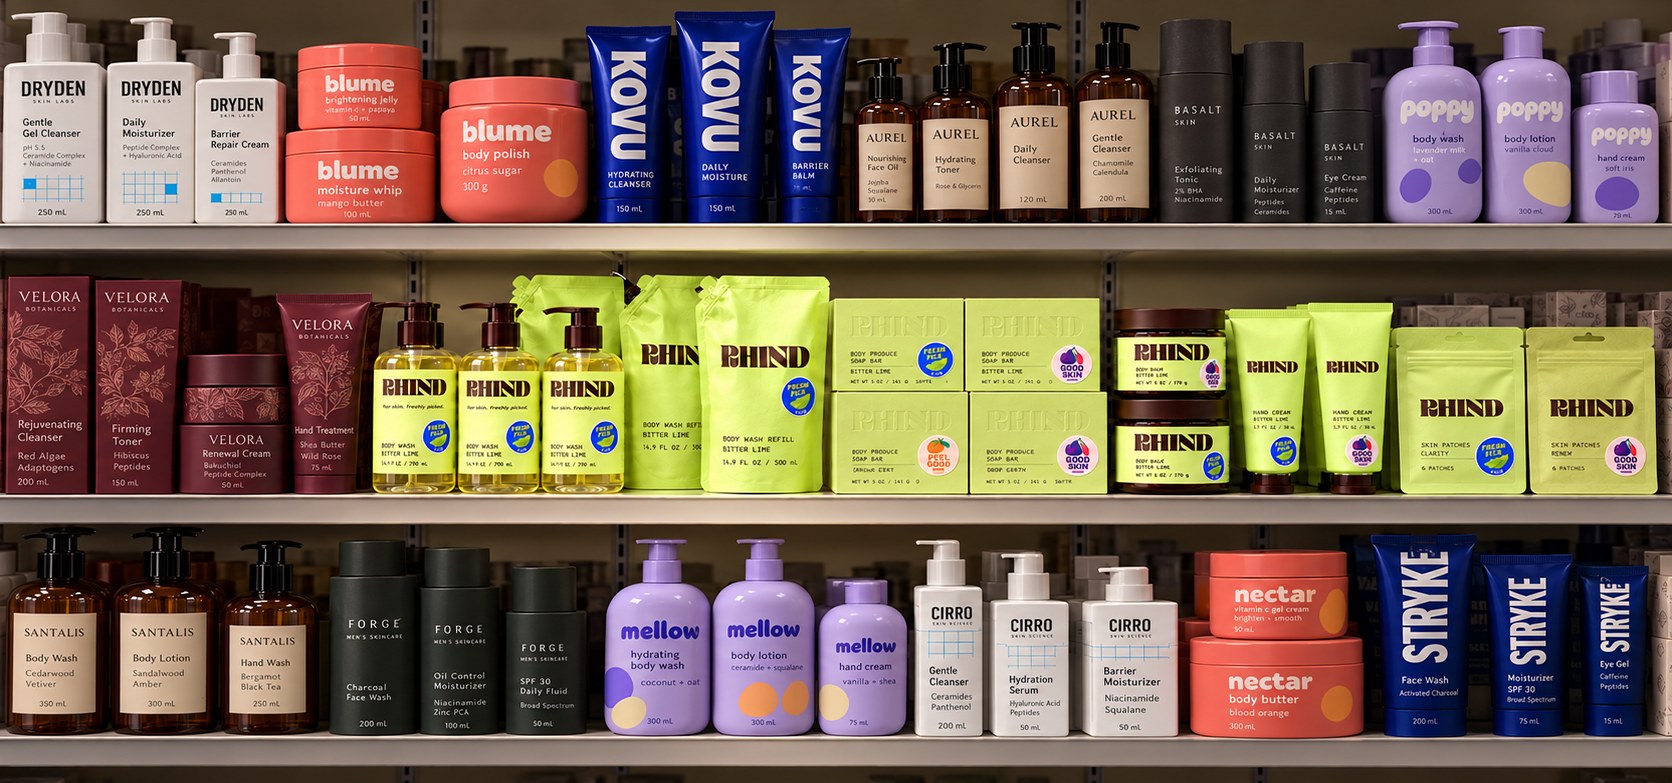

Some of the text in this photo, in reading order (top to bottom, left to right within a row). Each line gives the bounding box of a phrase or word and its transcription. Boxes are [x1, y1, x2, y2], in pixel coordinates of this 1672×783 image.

[22, 81, 85, 96] DRYDEN
[122, 81, 181, 96] DRYDEN
[325, 74, 394, 93] blume
[326, 96, 399, 105] brightening jelly
[700, 42, 740, 151] KOVU
[211, 98, 263, 111] DRYDEN
[609, 51, 647, 159] KOVU
[792, 56, 822, 151] KOVU
[1175, 106, 1221, 114] BASALT
[1400, 98, 1475, 126] poppy
[1496, 101, 1562, 124] poppy
[23, 118, 52, 126] Gentle
[123, 118, 146, 128] Daily
[1011, 117, 1058, 127] AUREL
[23, 129, 80, 137] Gel Cleanser
[463, 119, 551, 143] blume
[933, 129, 979, 139] AUREL
[1254, 132, 1295, 140] BASALT
[867, 133, 908, 142] AUREL
[1504, 135, 1527, 144] body
[1591, 128, 1652, 146] poppy
[212, 141, 238, 150] Repair
[1014, 145, 1037, 154] Daily
[463, 149, 531, 162] body polish
[934, 155, 976, 166] Hydrating
[318, 160, 398, 180] blume
[463, 166, 523, 177] citrus sugar
[1175, 166, 1222, 175] Exfoliating
[1324, 174, 1338, 182] Eye
[318, 185, 403, 196] moisture whip
[19, 291, 80, 302] VELORA
[105, 292, 169, 303] VELORA
[292, 320, 352, 330] VELORA
[850, 315, 949, 337] RHIND
[982, 315, 1082, 337] RHIND
[721, 345, 810, 368] RHIND
[1135, 344, 1210, 360] RHIND
[1059, 364, 1086, 372] GOOD
[1247, 361, 1298, 373] RHIND
[1327, 361, 1379, 373] RHIND
[383, 379, 446, 396] RHIND
[467, 380, 530, 397] RHIND
[551, 381, 614, 397] RHIND
[1420, 399, 1503, 417] RHIND
[1550, 399, 1634, 417] RHIND
[18, 420, 82, 431] Rejuvenating
[112, 424, 151, 436] Firming
[18, 433, 62, 442] Cleanser
[112, 437, 142, 446] Toner
[210, 435, 263, 445] VELORA
[1135, 434, 1213, 451] RHIND
[18, 452, 65, 462] Red Algae
[203, 450, 239, 458] Renewal
[927, 453, 950, 462] PEEL
[1064, 455, 1092, 464] GOOD
[926, 460, 952, 468] GOOD
[1235, 586, 1316, 602] nectar
[1400, 550, 1448, 663] STRYKE
[932, 606, 972, 620] CIRRO
[1600, 584, 1630, 652] STRYKE
[1011, 619, 1052, 632] CIRRO
[1110, 619, 1150, 632] CIRRO
[1508, 578, 1546, 665] STRYKE
[25, 628, 84, 637] SANTALIS
[132, 628, 194, 636] SANTALIS
[434, 625, 482, 634] FORGE
[622, 620, 700, 640] mellow
[728, 619, 800, 638] mellow
[835, 638, 896, 653] mellow
[26, 654, 78, 664] Body Wash
[132, 654, 156, 664] Body
[630, 650, 679, 660] hydrating
[730, 652, 755, 661] body
[630, 660, 684, 671] body wash
[840, 663, 862, 672] hand
[930, 666, 958, 674] Gentle
[1600, 661, 1614, 669] Eye
[25, 670, 76, 678] Cedarwood
[930, 678, 968, 686] Cleanser
[1010, 676, 1052, 685] Hydration
[1229, 673, 1312, 690] nectar
[1402, 676, 1422, 684] Face
[1010, 686, 1038, 694] Serum
[1230, 694, 1298, 706] body butter
[1258, 710, 1290, 718] orange
